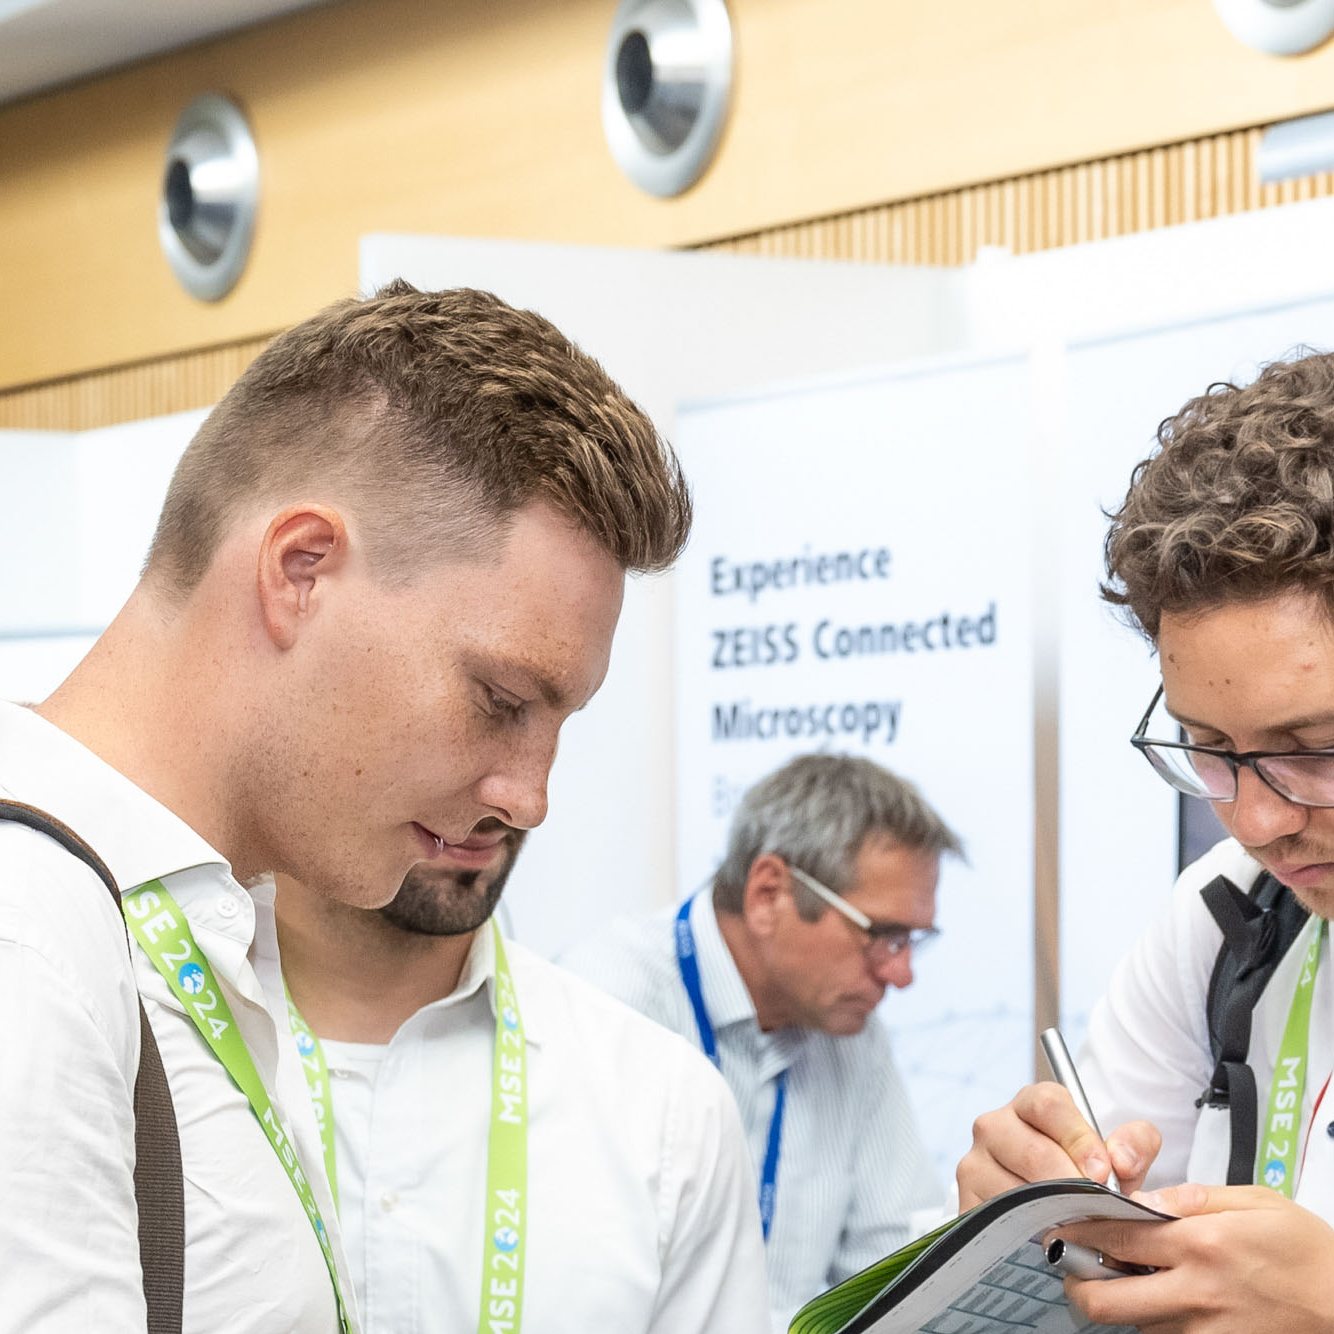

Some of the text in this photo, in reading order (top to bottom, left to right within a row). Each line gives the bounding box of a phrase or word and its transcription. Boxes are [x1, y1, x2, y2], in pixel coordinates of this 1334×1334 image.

[711, 546, 891, 601] Experience
[712, 601, 997, 670] ZEISS Connected
[712, 699, 903, 746] Microscopy
[126, 890, 178, 945] SE
[498, 1053, 523, 1125] MSE
[1270, 1056, 1302, 1134] MSE
[263, 1106, 305, 1193] MSE
[492, 1187, 521, 1271] 2024
